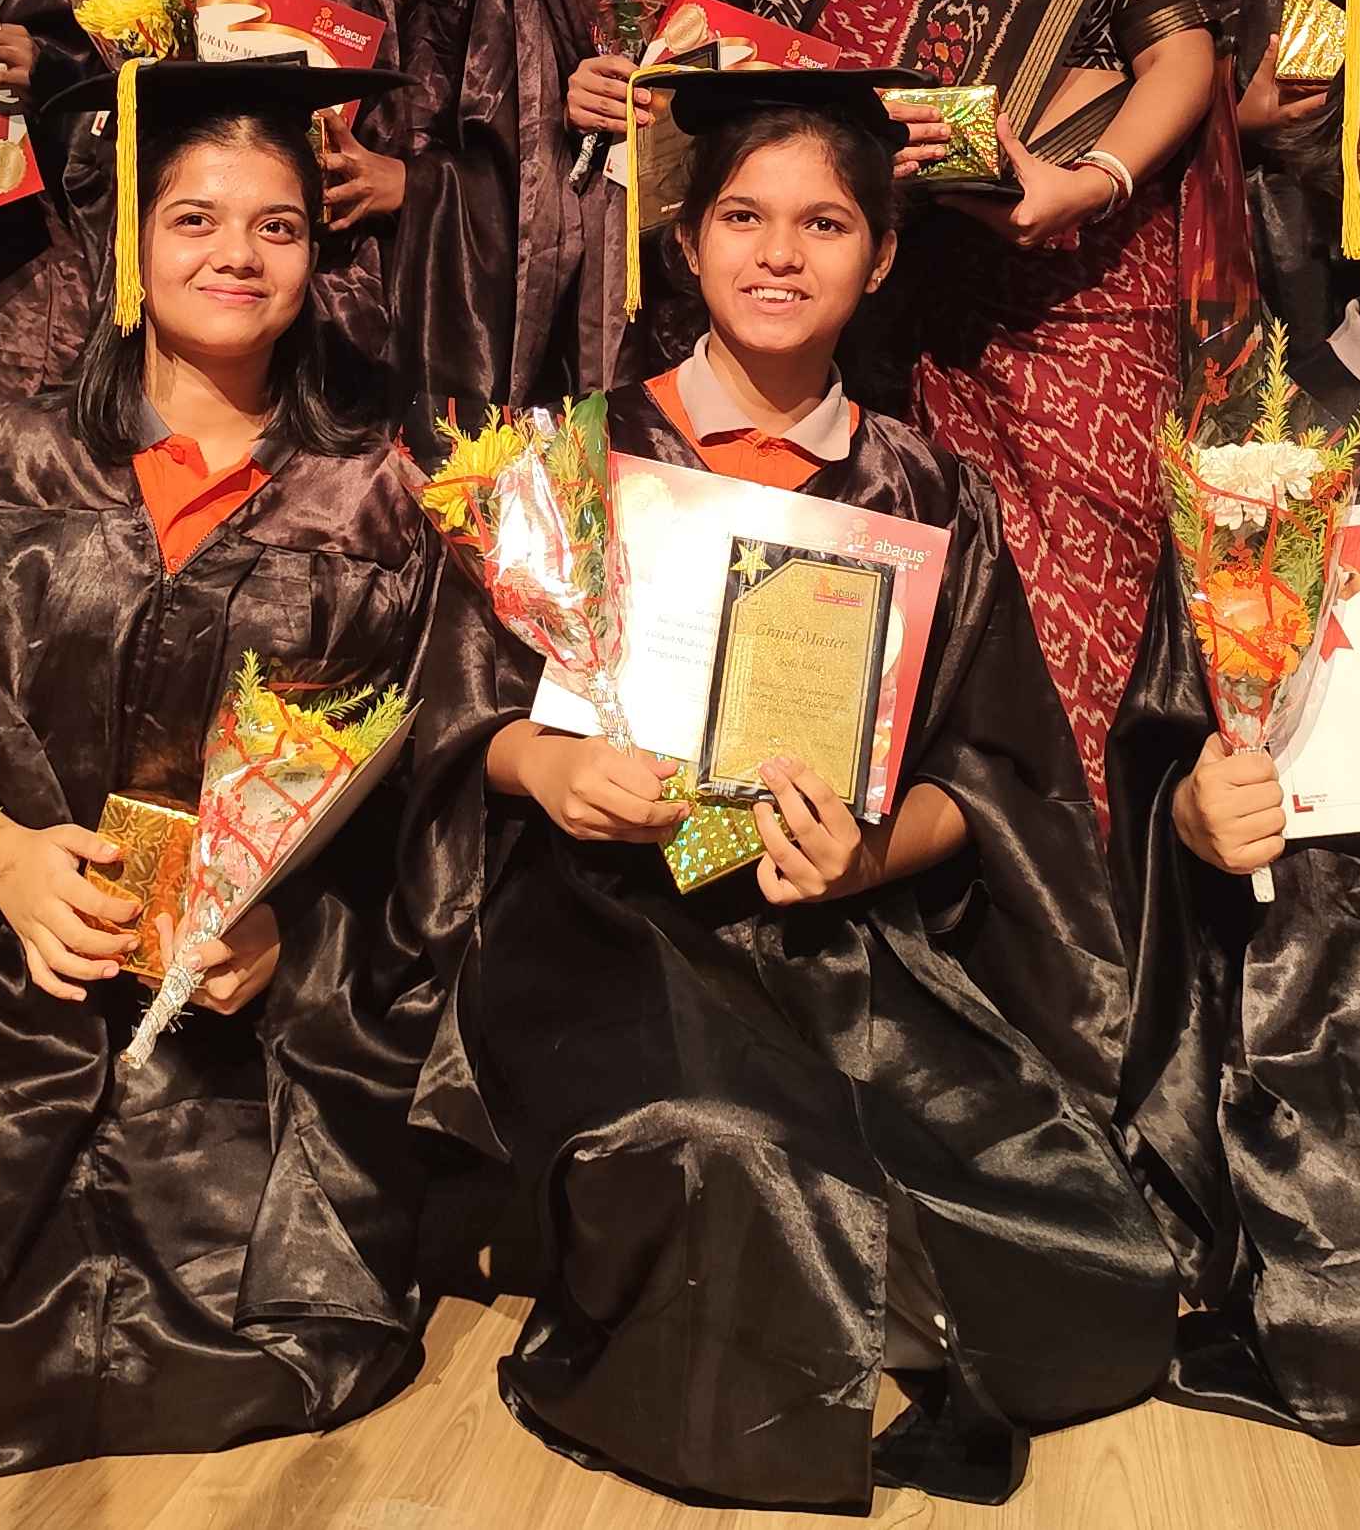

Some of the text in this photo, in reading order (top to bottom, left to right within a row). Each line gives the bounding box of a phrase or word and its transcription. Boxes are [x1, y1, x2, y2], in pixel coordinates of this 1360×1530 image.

[873, 538, 926, 563] abacus
[755, 622, 849, 650] Grand Master
